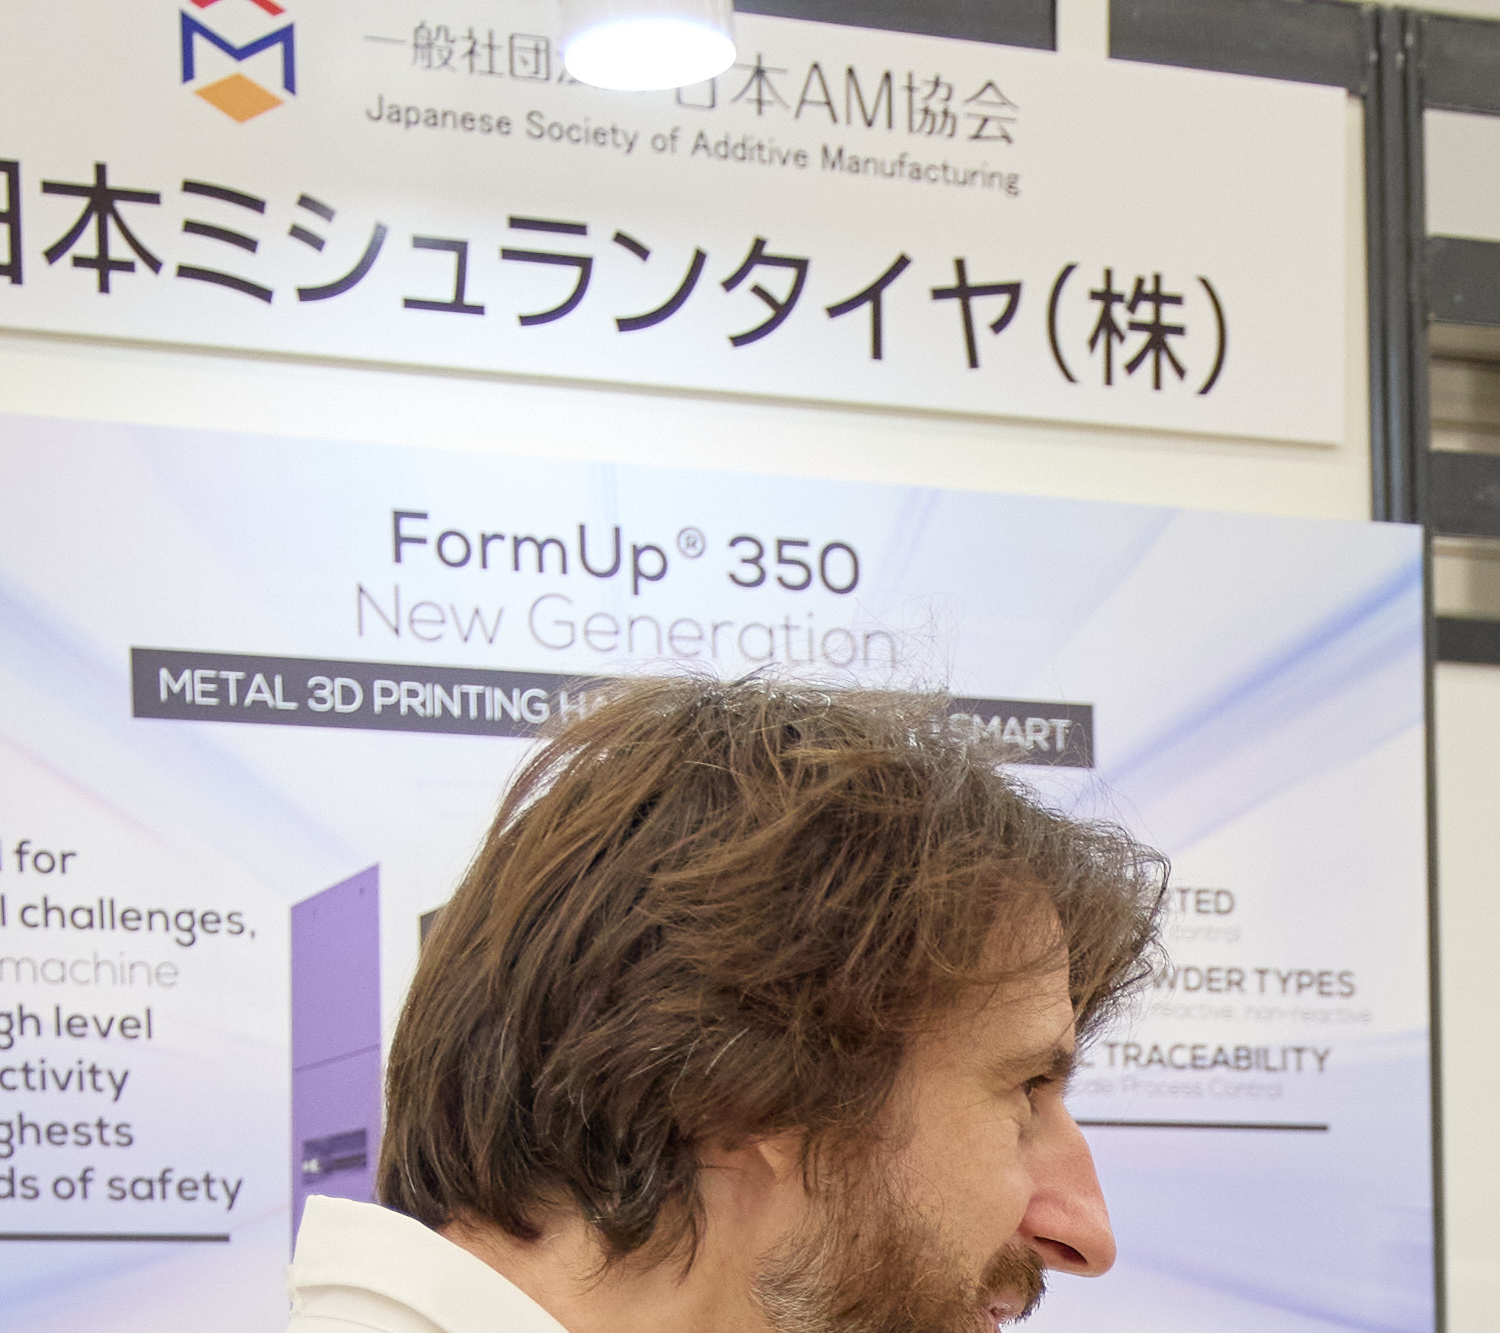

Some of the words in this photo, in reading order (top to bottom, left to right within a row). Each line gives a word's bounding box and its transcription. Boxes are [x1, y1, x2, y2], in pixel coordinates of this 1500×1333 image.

[364, 20, 578, 84] 一般社団
[365, 94, 512, 137] Japanese
[526, 112, 639, 154] Society
[651, 126, 679, 153] of
[692, 130, 809, 169] Additive
[821, 145, 1021, 196] Manufacturing
[729, 535, 860, 595] 350
[357, 582, 504, 646] New
[529, 591, 899, 670] Generation
[158, 666, 298, 711] METAL
[307, 675, 363, 714] 3D
[373, 679, 551, 724] PRINTING
[948, 712, 1073, 753] SMART
[14, 840, 77, 875] for
[19, 896, 257, 947] challenges,
[1254, 968, 1356, 998] TYPES
[54, 1005, 155, 1042] level
[1104, 1042, 1332, 1073] TRACEABILITY
[1122, 1075, 1202, 1098] Process
[1209, 1077, 1282, 1099] Control
[52, 1167, 97, 1202] of
[107, 1168, 244, 1211] safety
